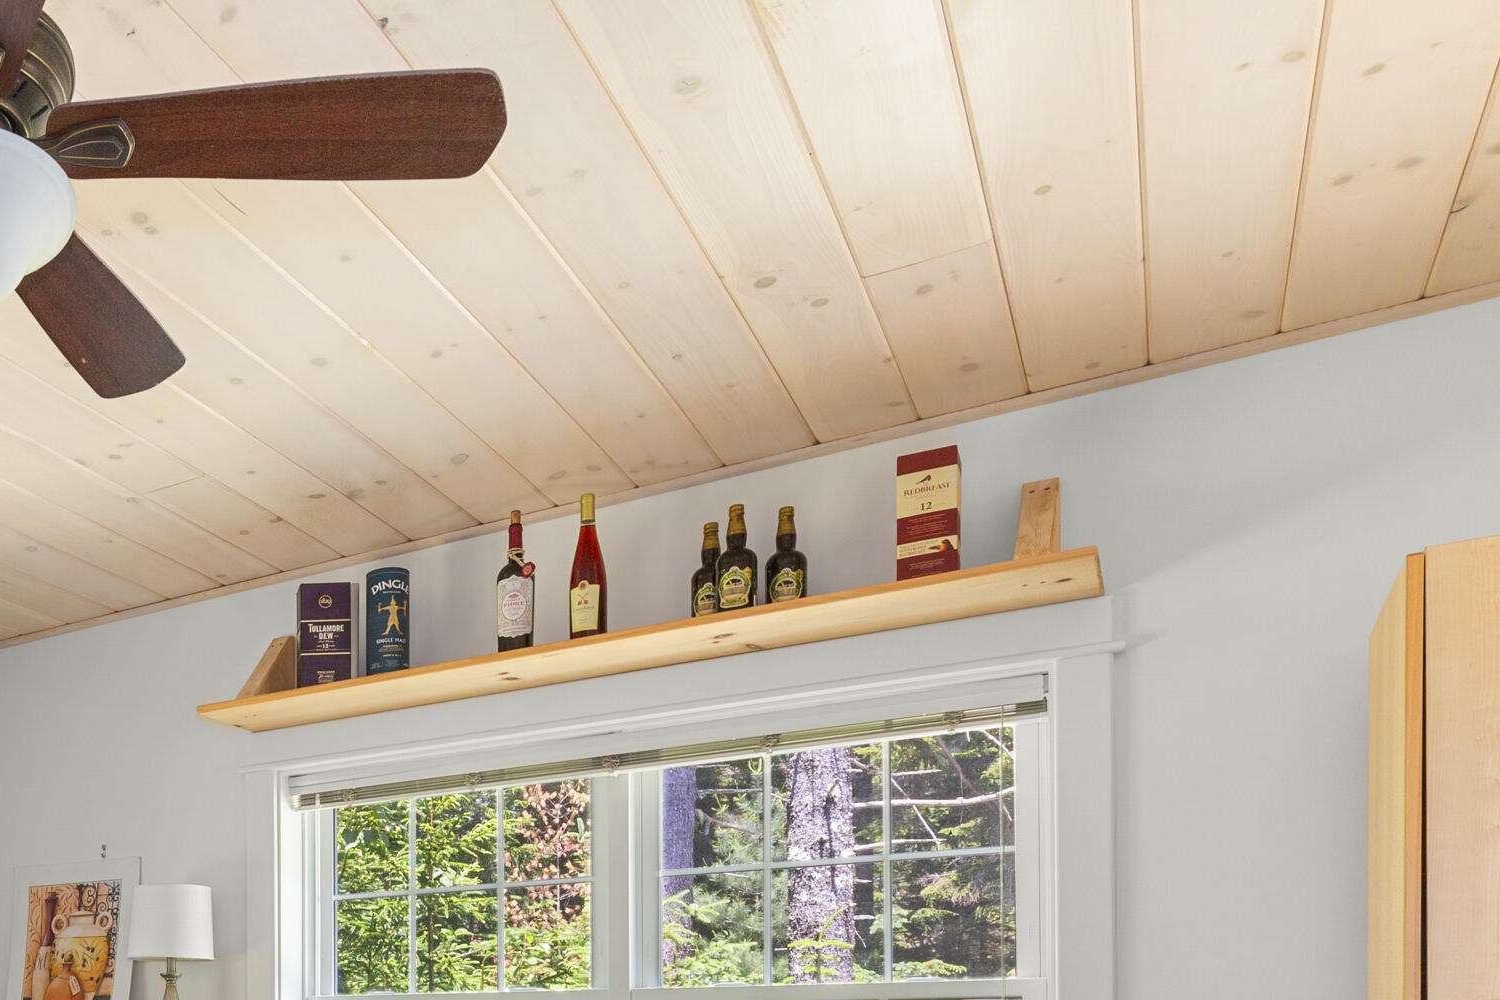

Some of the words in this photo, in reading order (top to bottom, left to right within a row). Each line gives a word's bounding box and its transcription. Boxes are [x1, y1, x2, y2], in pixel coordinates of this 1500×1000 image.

[904, 482, 950, 496] REDBREAST
[920, 501, 933, 511] 12
[308, 623, 345, 633] TULLAMORE
[318, 632, 334, 640] DEW
